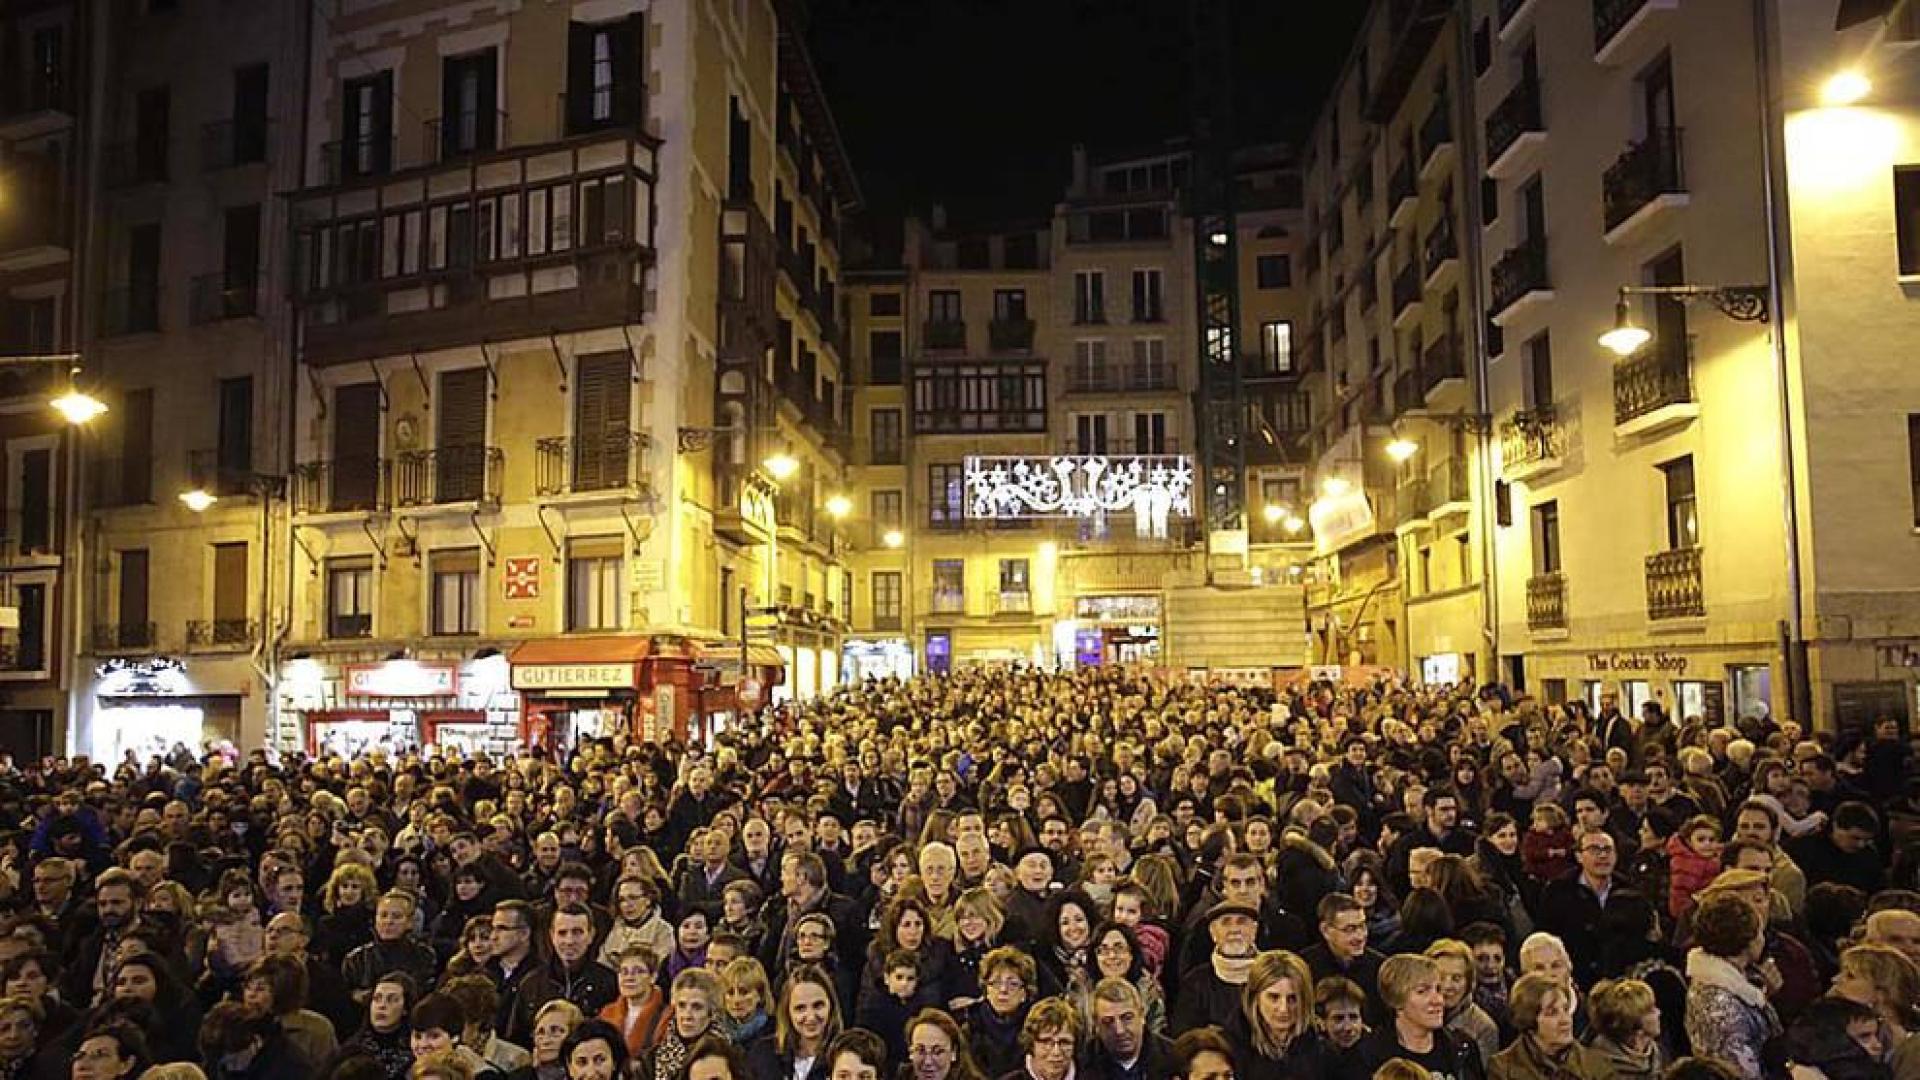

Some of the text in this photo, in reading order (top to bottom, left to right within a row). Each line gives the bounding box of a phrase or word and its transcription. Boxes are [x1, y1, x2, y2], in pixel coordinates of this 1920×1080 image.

[1586, 651, 1688, 676] The Cookie Shop
[522, 667, 622, 683] GUTIERREZ
